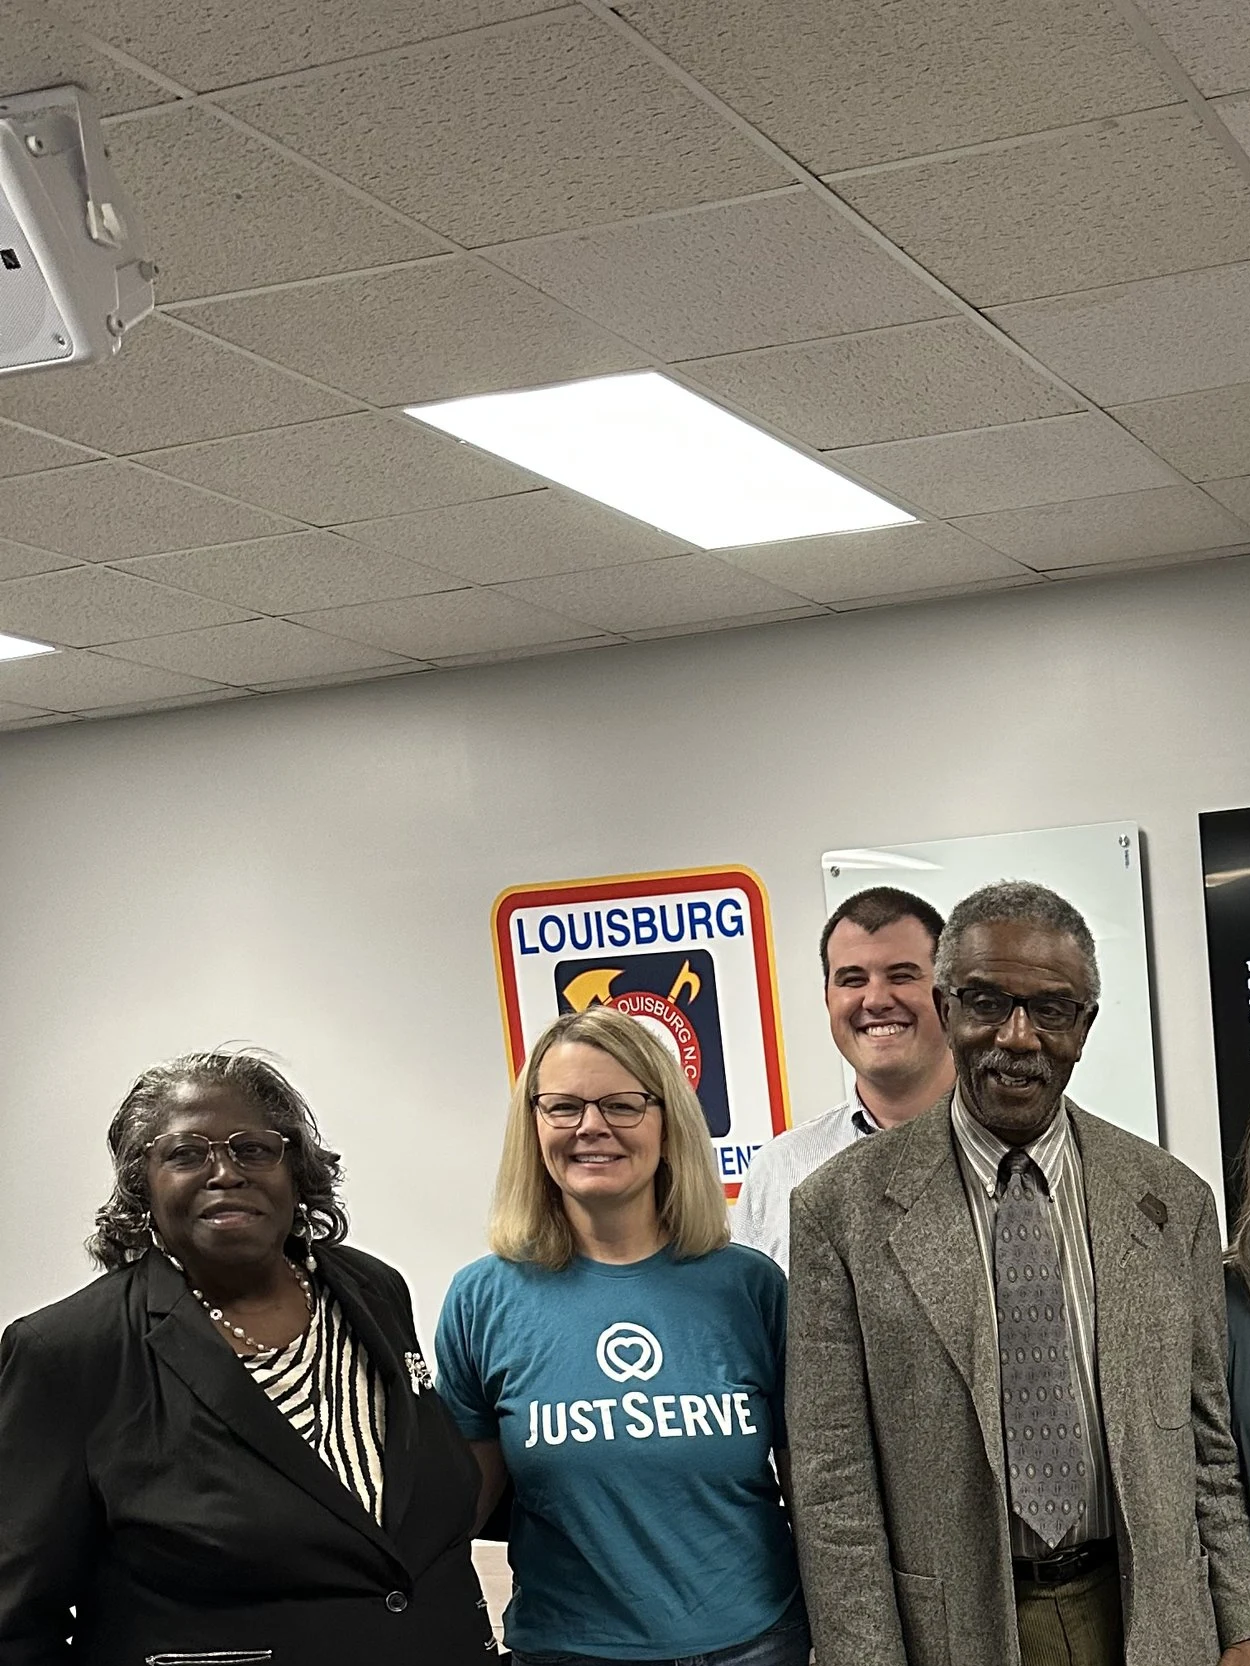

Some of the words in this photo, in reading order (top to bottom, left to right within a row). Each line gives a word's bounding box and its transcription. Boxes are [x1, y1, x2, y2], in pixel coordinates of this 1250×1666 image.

[516, 898, 744, 955] LOUISBURG
[617, 996, 691, 1043] OUISBURG
[525, 1391, 757, 1449] JUSTSERVE
